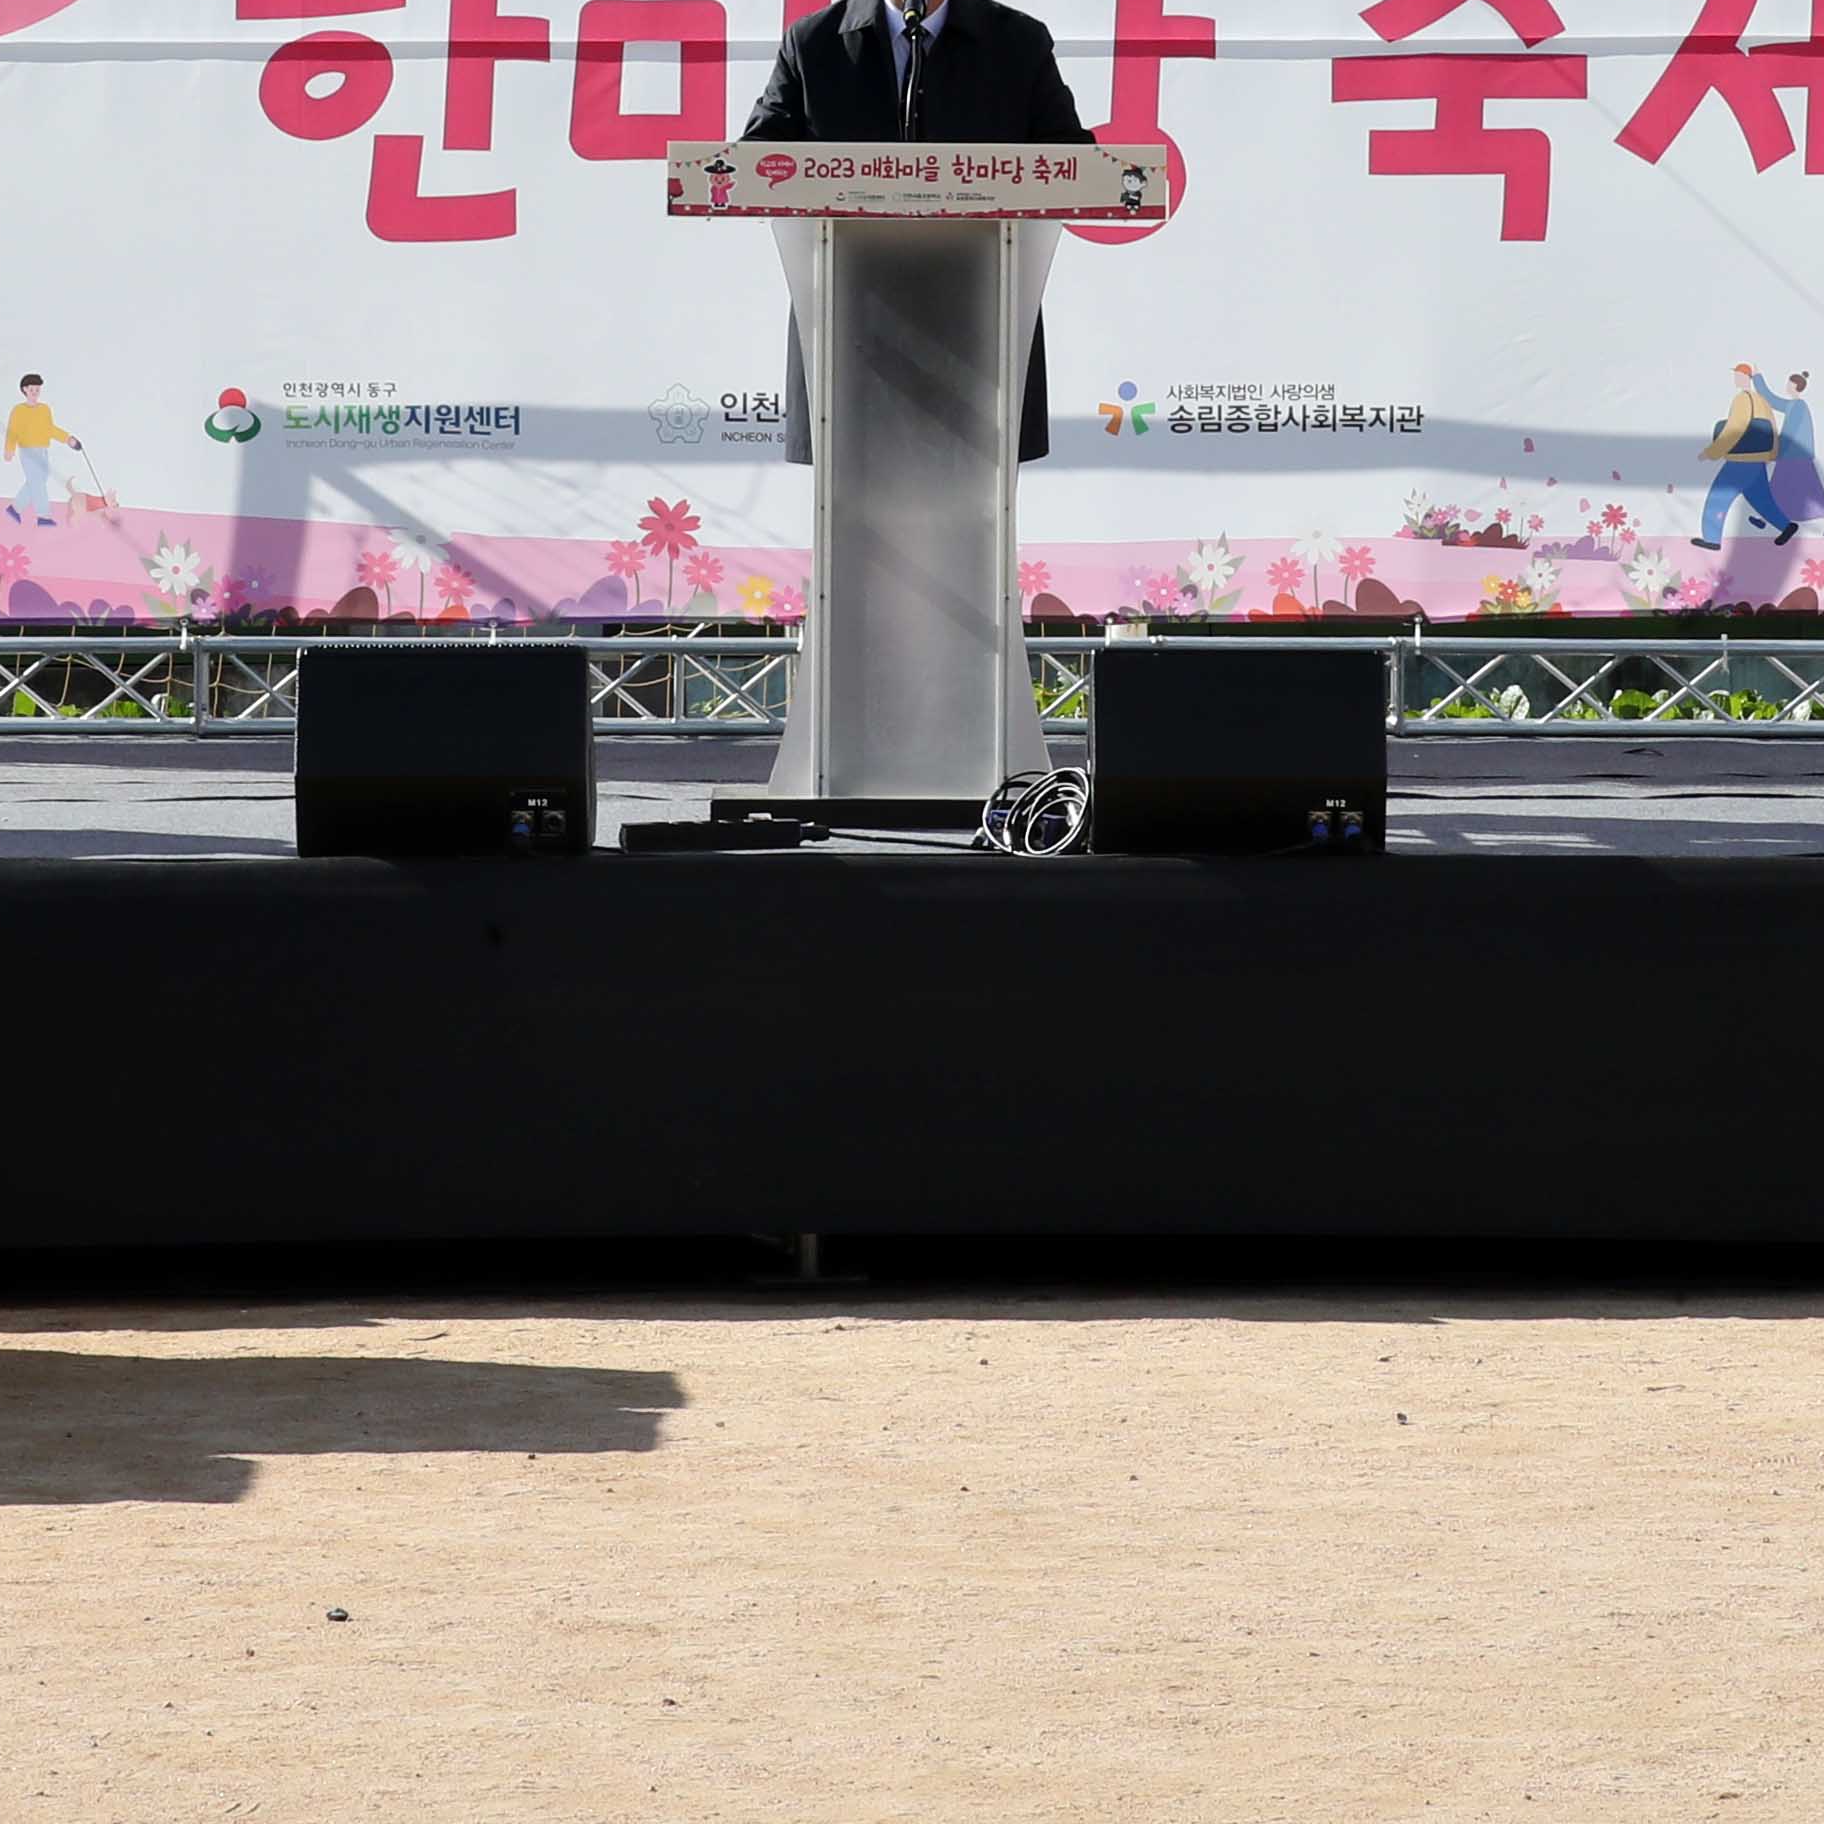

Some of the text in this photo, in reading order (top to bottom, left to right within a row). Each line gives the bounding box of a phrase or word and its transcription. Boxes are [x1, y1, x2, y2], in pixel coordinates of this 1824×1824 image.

[803, 153, 1077, 184] 2023 매화마을 한마당 축제
[282, 382, 398, 398] 인천광역시 동구
[1166, 383, 1335, 401] 사회복지법인 사랑의샘
[720, 392, 786, 423] 인천
[283, 404, 521, 435] 도시재생지원센터
[1167, 404, 1423, 433] 송림종합사회복지관
[721, 431, 772, 443] INCHEON
[527, 798, 548, 807] M12
[1325, 799, 1346, 808] M12
